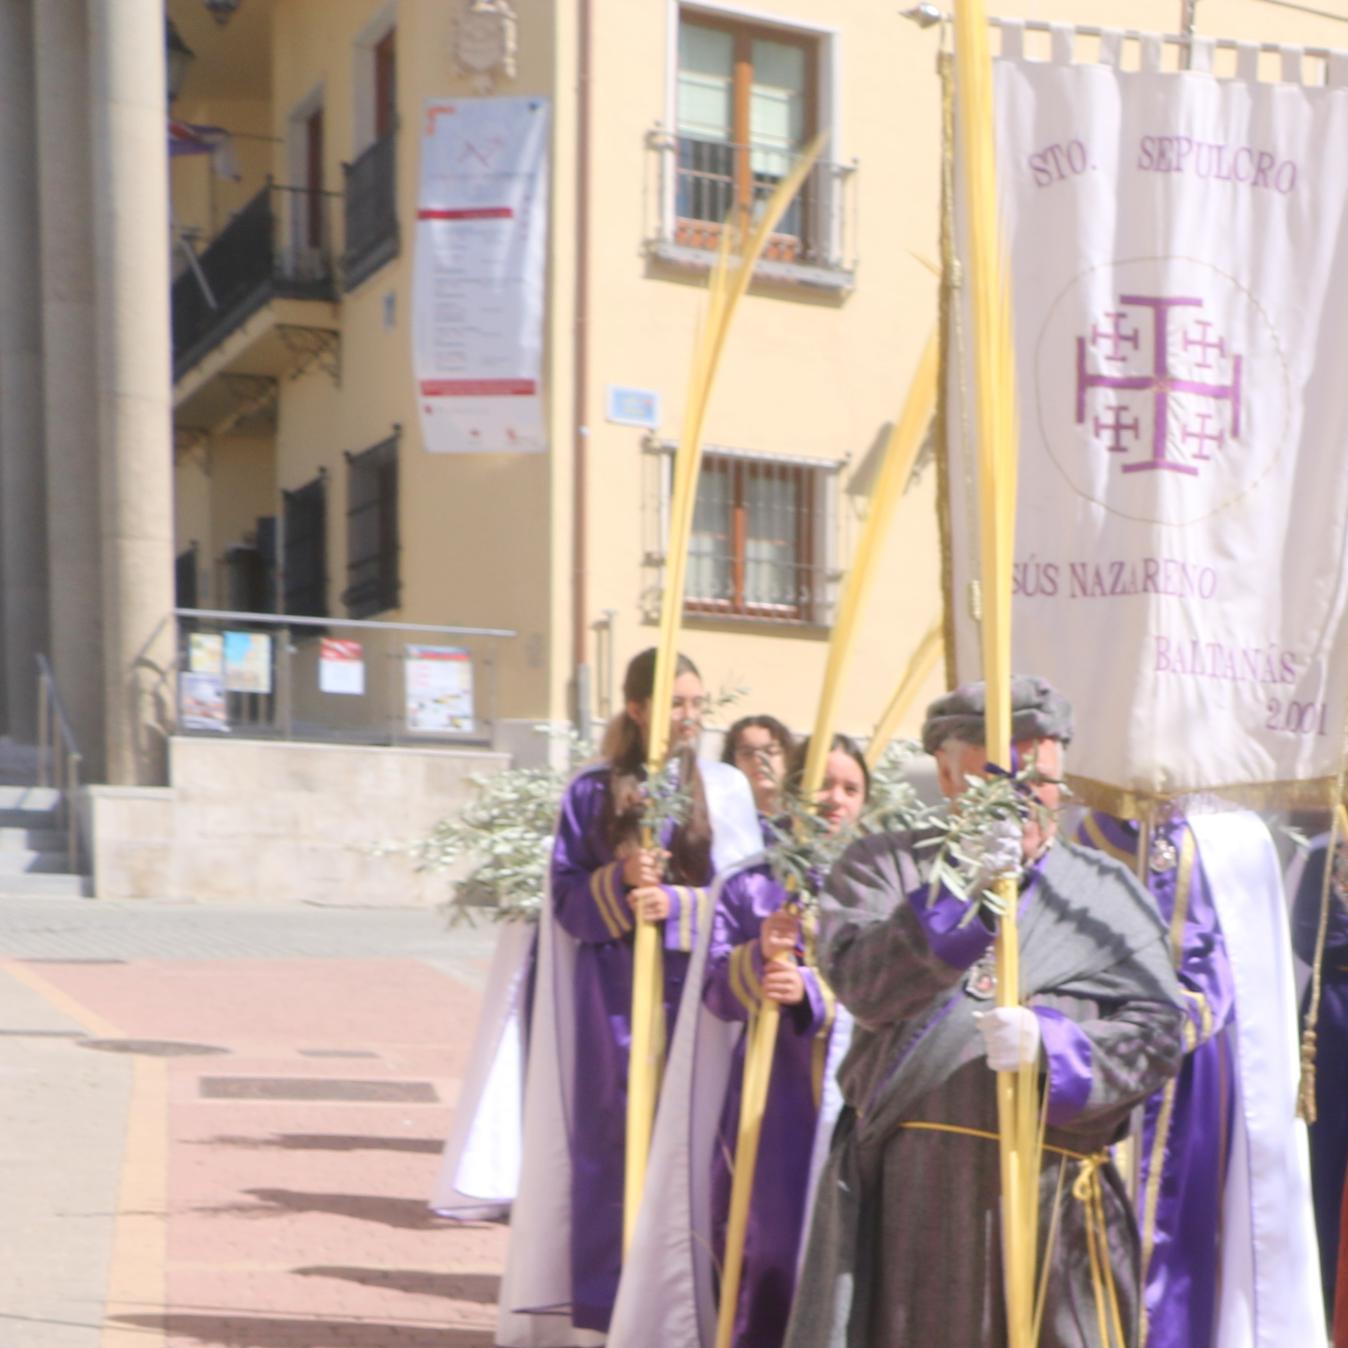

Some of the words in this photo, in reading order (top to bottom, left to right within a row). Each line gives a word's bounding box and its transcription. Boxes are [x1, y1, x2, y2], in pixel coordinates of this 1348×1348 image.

[1027, 138, 1097, 188] STO.
[1137, 134, 1298, 194] SEPULCRO
[1012, 553, 1059, 597] SÚS
[1069, 557, 1217, 599] NAZARENO
[1154, 634, 1297, 684] BALTANÁS
